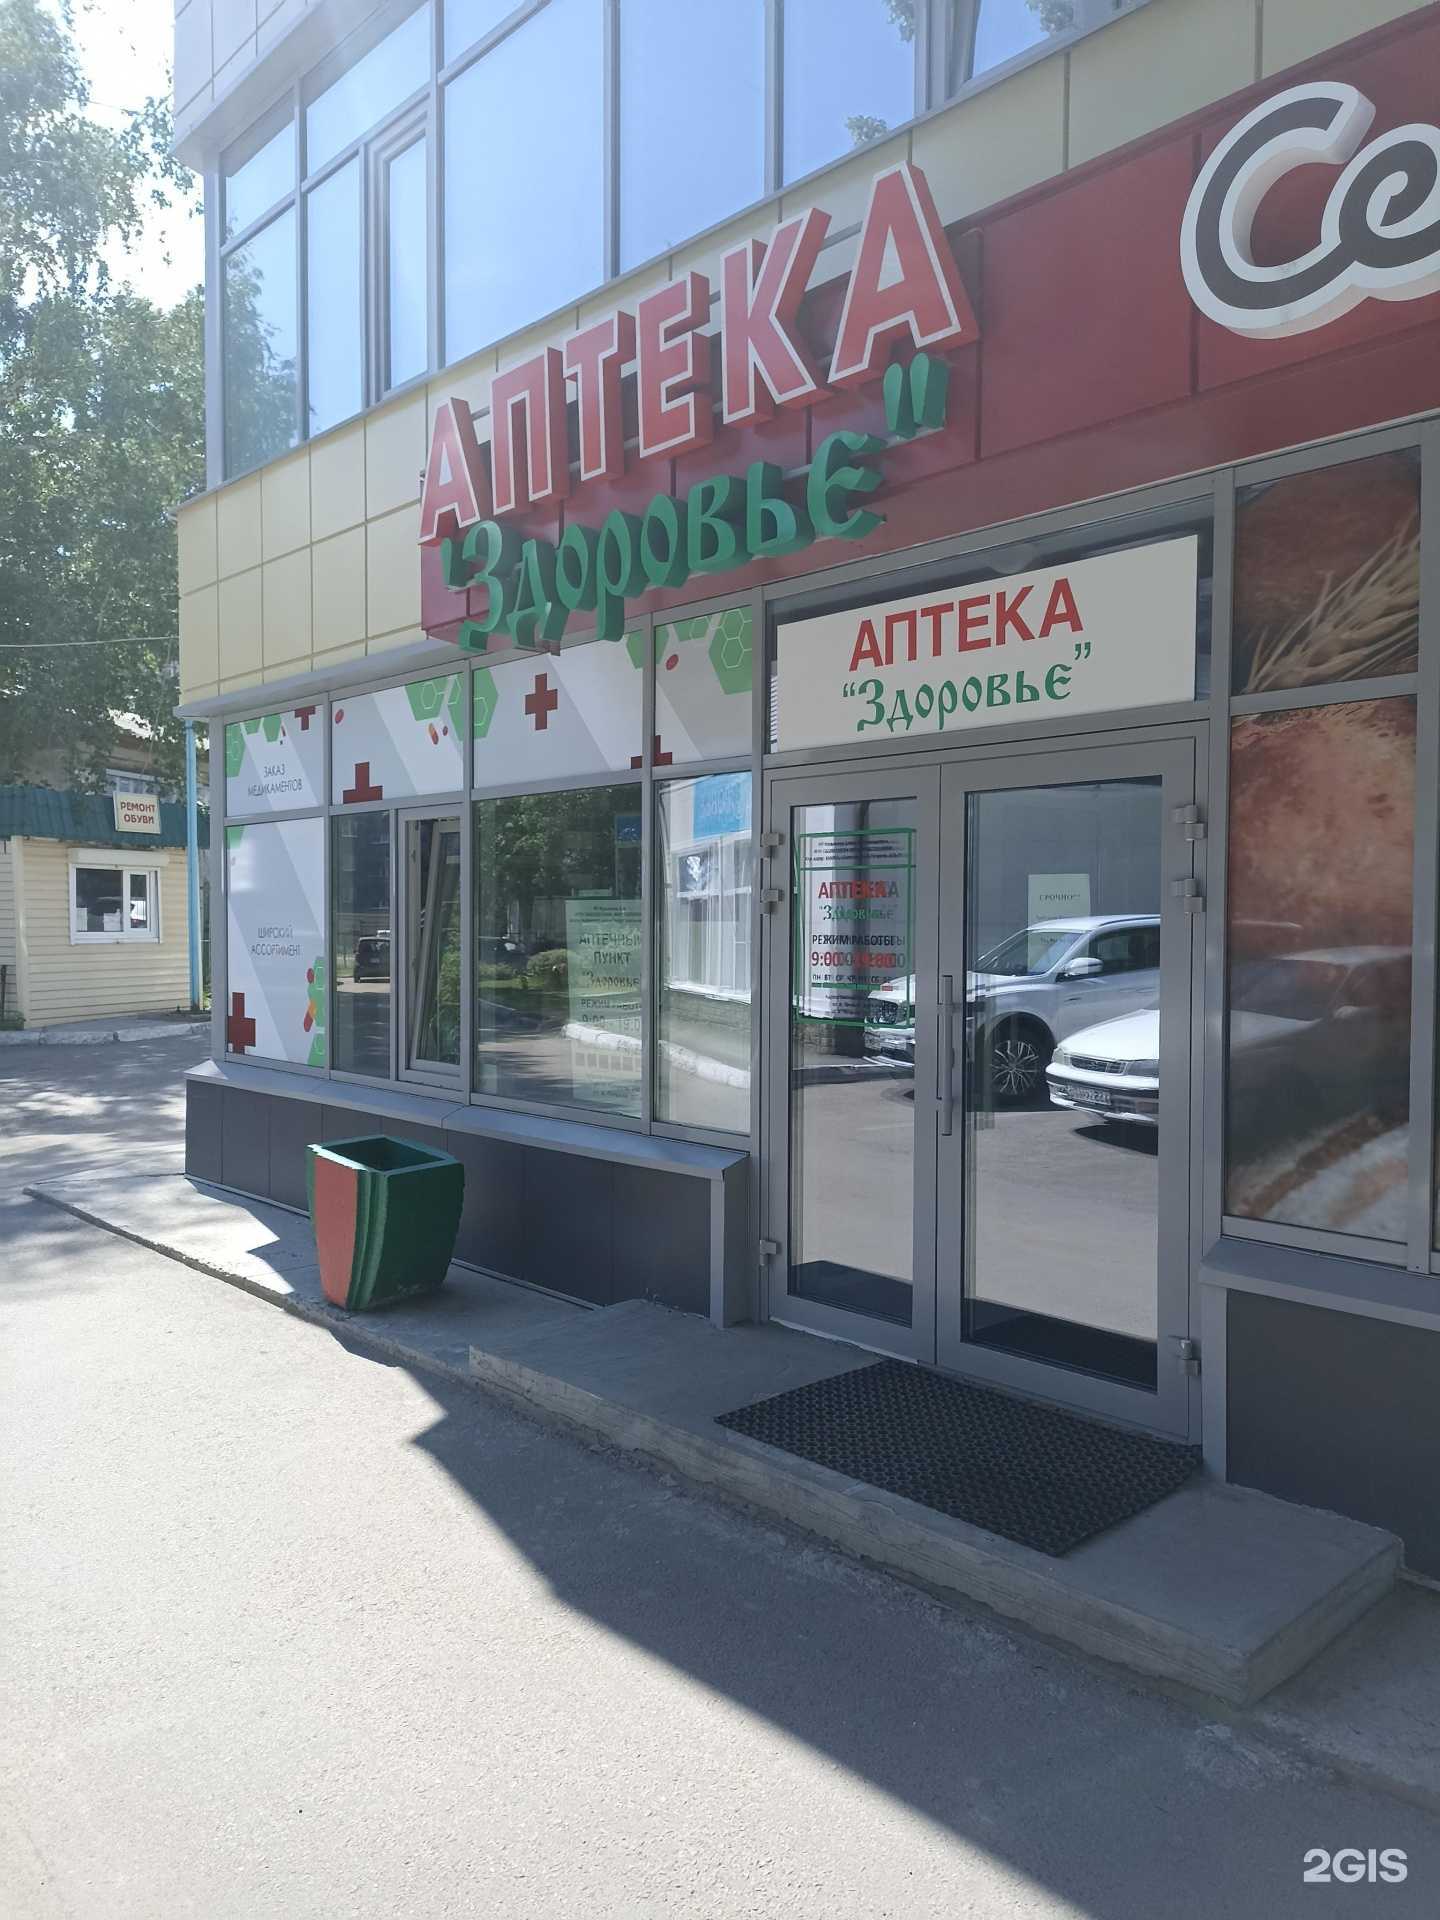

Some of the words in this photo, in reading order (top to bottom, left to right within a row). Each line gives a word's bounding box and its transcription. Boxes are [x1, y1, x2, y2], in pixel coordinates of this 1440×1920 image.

[418, 160, 981, 546] АПТЕКА
[849, 577, 1084, 672] АПТЕКА
[263, 763, 287, 778] ЗАКАЗ
[247, 778, 304, 797] МЕДИКАМЕНТОВ
[120, 801, 157, 813] РЕМОНТ
[123, 813, 155, 825] ОБУВИ
[818, 880, 899, 899] АПТЕКА
[257, 924, 294, 940] ШИРОКИЙ
[250, 943, 301, 957] АССОРТИМЕНТ
[593, 951, 632, 965] ПУНКТ
